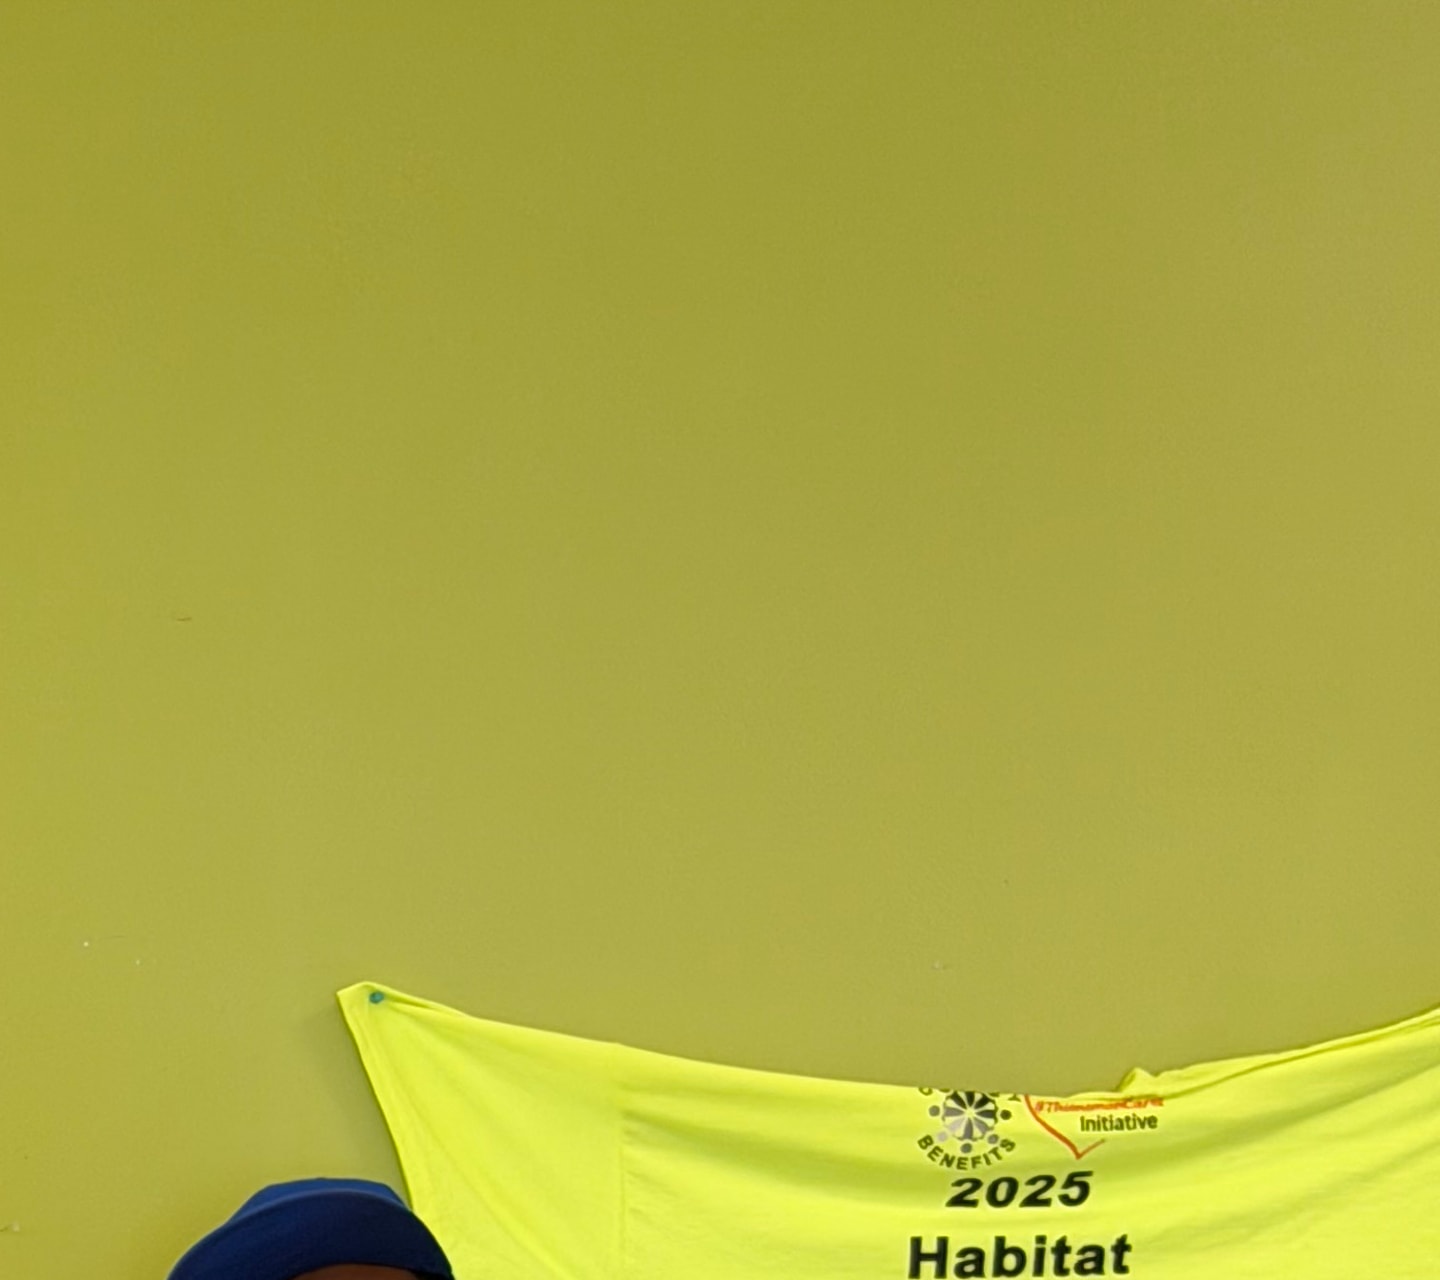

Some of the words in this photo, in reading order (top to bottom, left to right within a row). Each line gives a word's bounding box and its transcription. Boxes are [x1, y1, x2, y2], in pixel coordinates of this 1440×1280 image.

[1080, 1113, 1158, 1132] Initiative
[916, 1134, 1016, 1171] BENEFITS
[945, 1171, 1094, 1208] 2025
[907, 1234, 1133, 1280] Habitat
